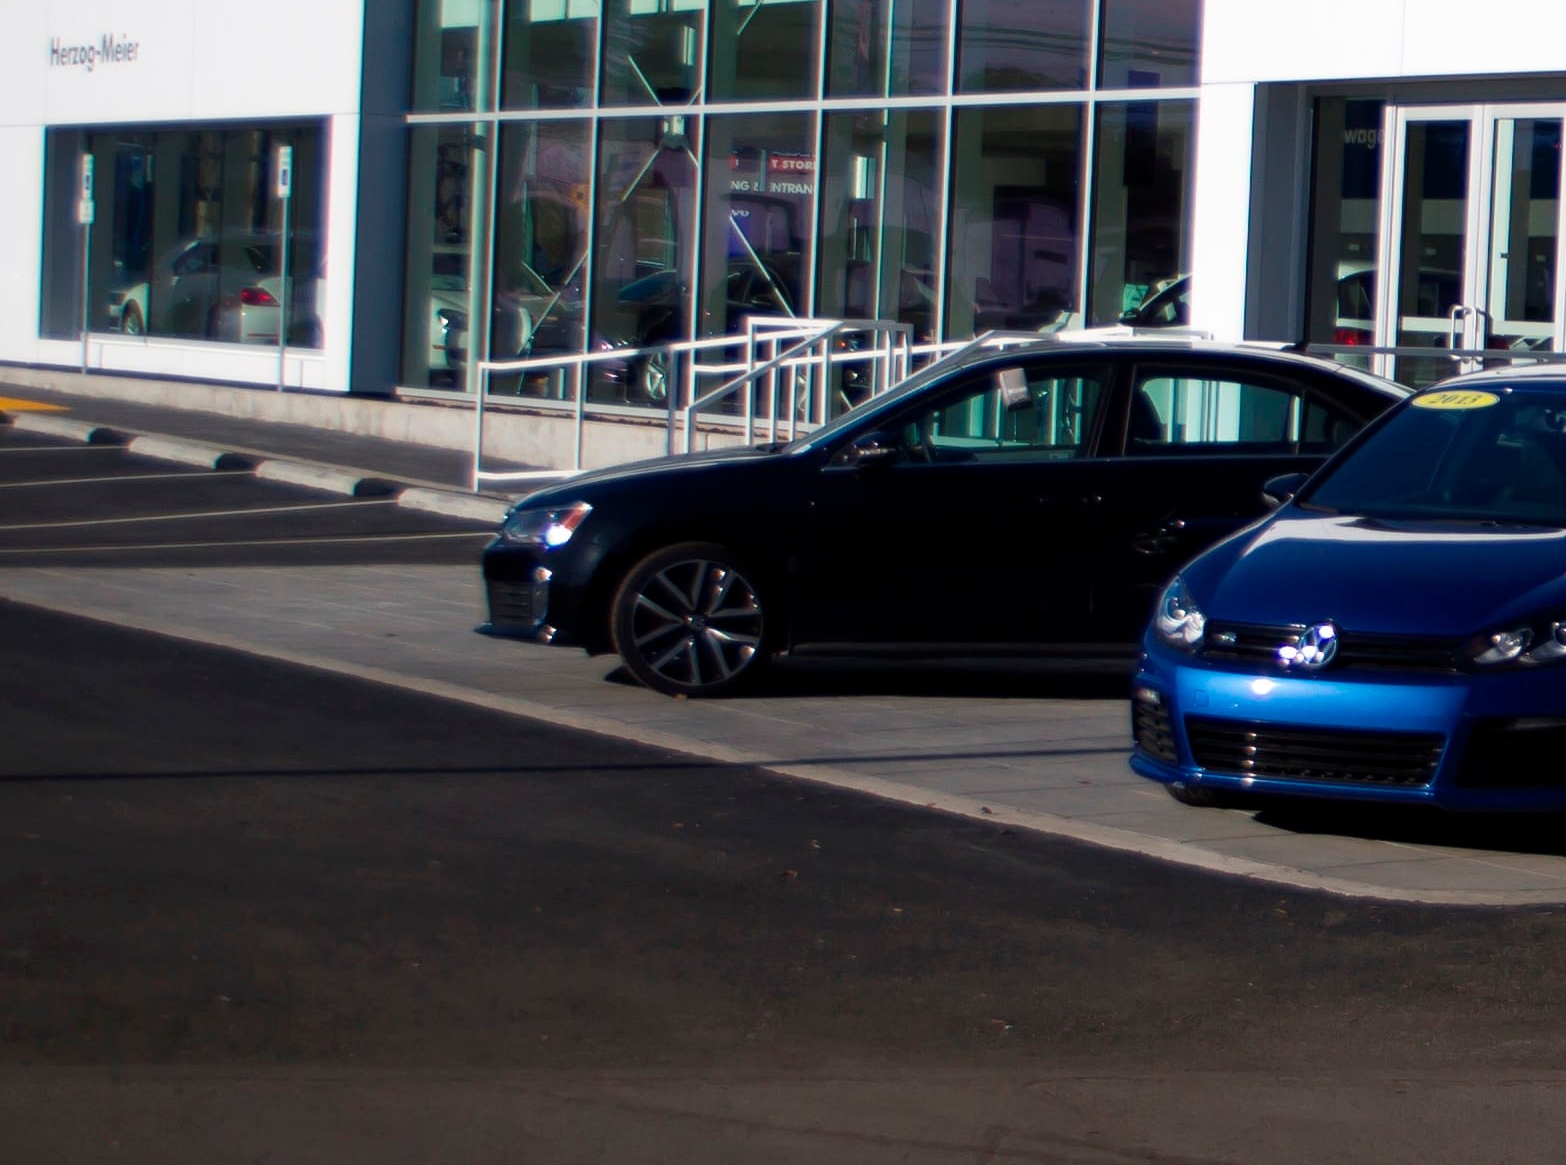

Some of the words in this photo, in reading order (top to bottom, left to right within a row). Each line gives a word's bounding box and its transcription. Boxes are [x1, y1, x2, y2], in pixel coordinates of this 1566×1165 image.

[51, 33, 138, 72] Herzog-Meier
[781, 159, 816, 170] STOR
[769, 182, 813, 194] NTRAN
[1428, 394, 1483, 405] 2013
